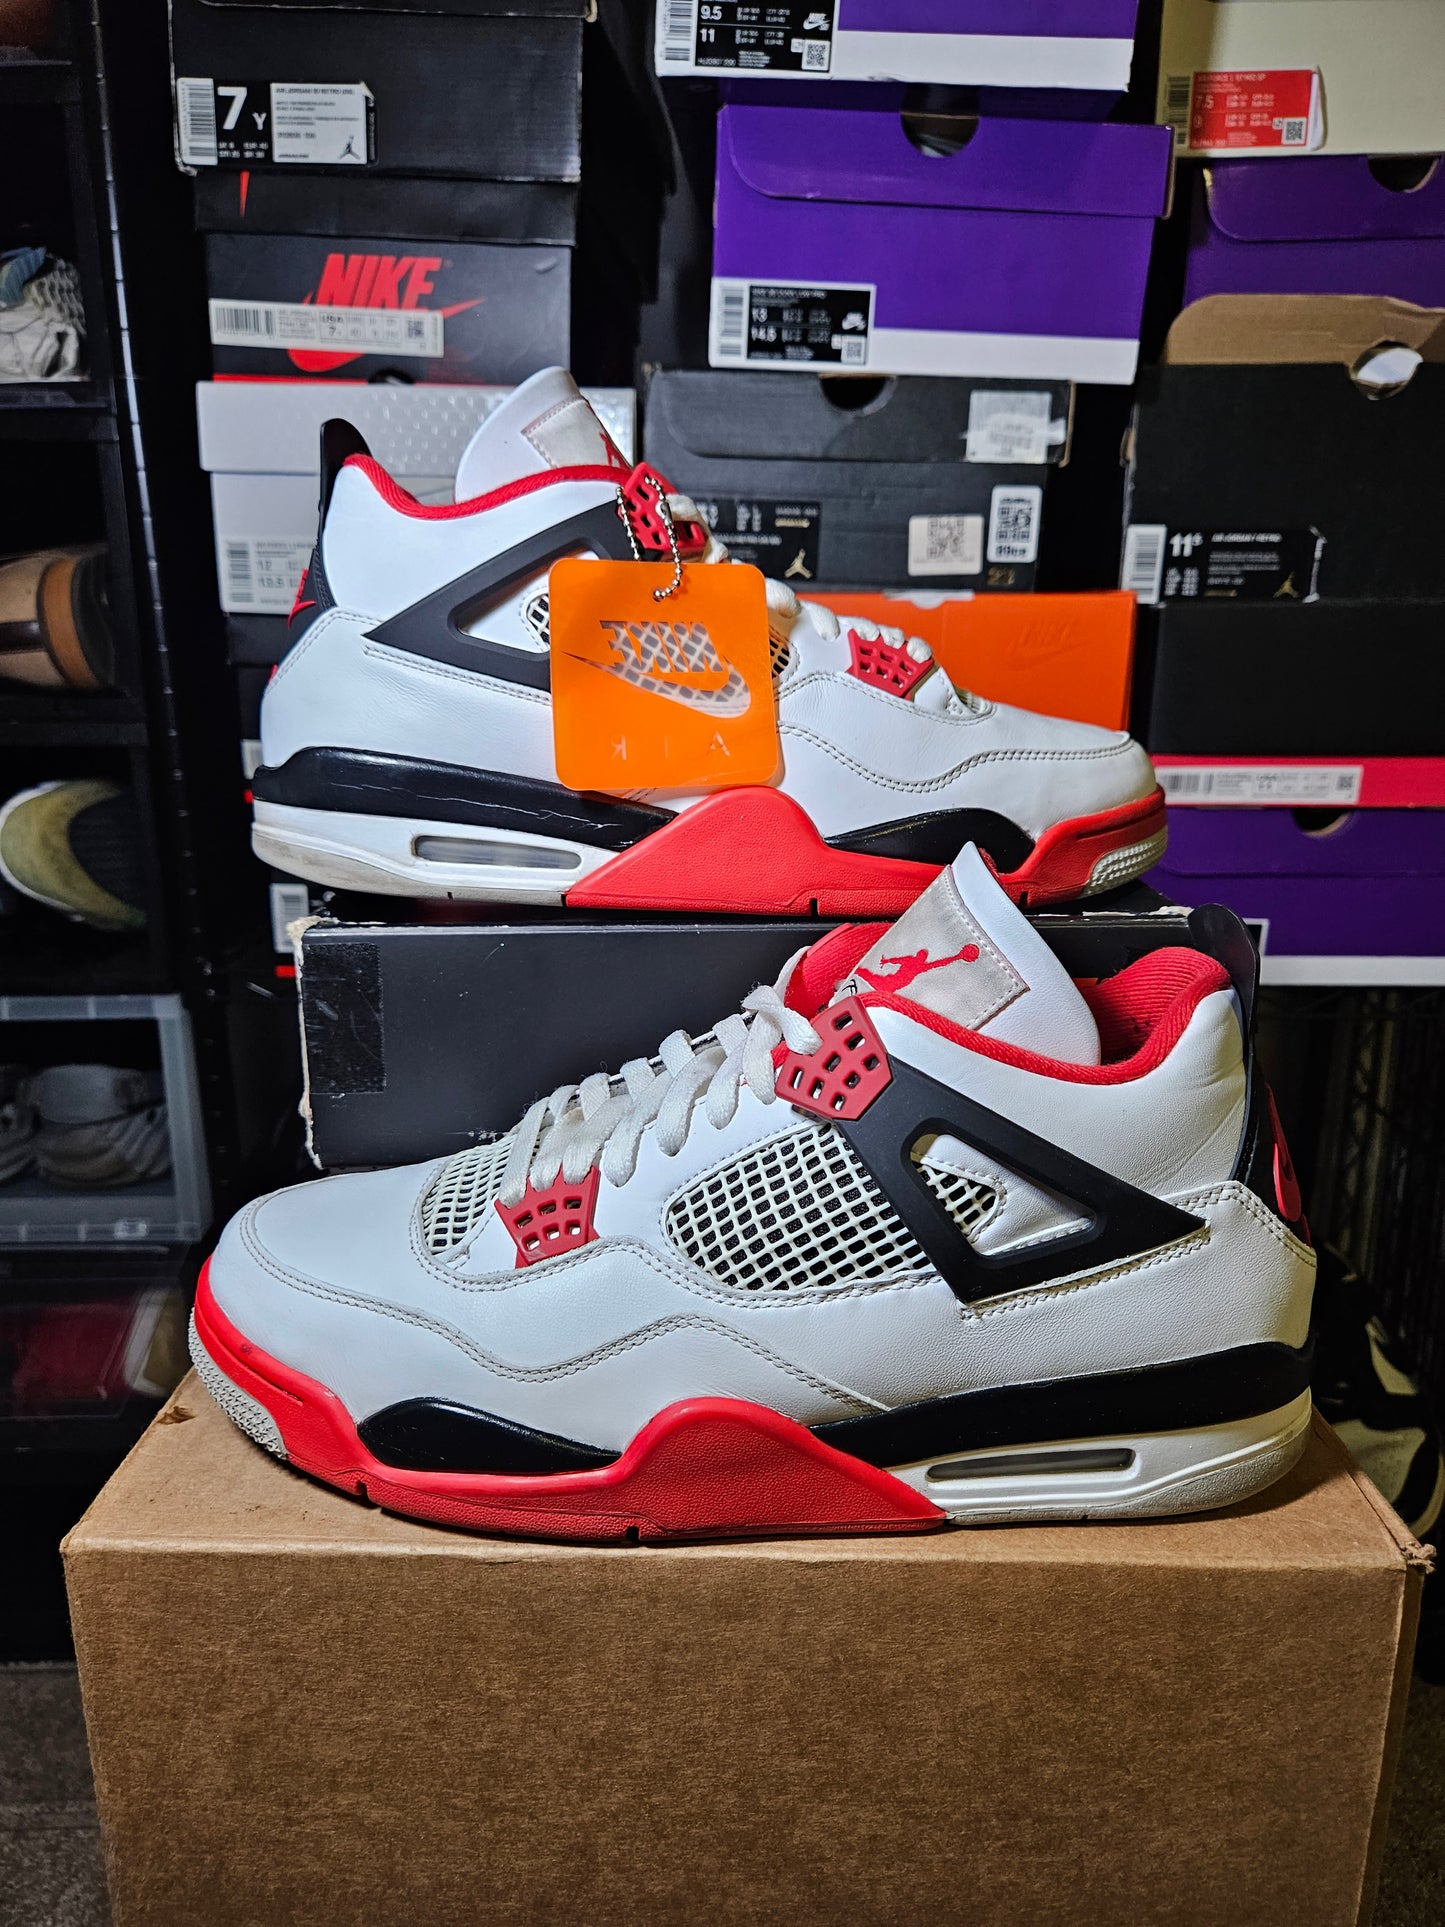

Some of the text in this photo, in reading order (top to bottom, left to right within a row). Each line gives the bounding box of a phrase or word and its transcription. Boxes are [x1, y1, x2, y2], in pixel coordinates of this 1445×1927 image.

[700, 5, 722, 20] 9.5
[700, 28, 715, 42] 11
[217, 86, 267, 131] 7 Y
[315, 253, 442, 312] NIKE
